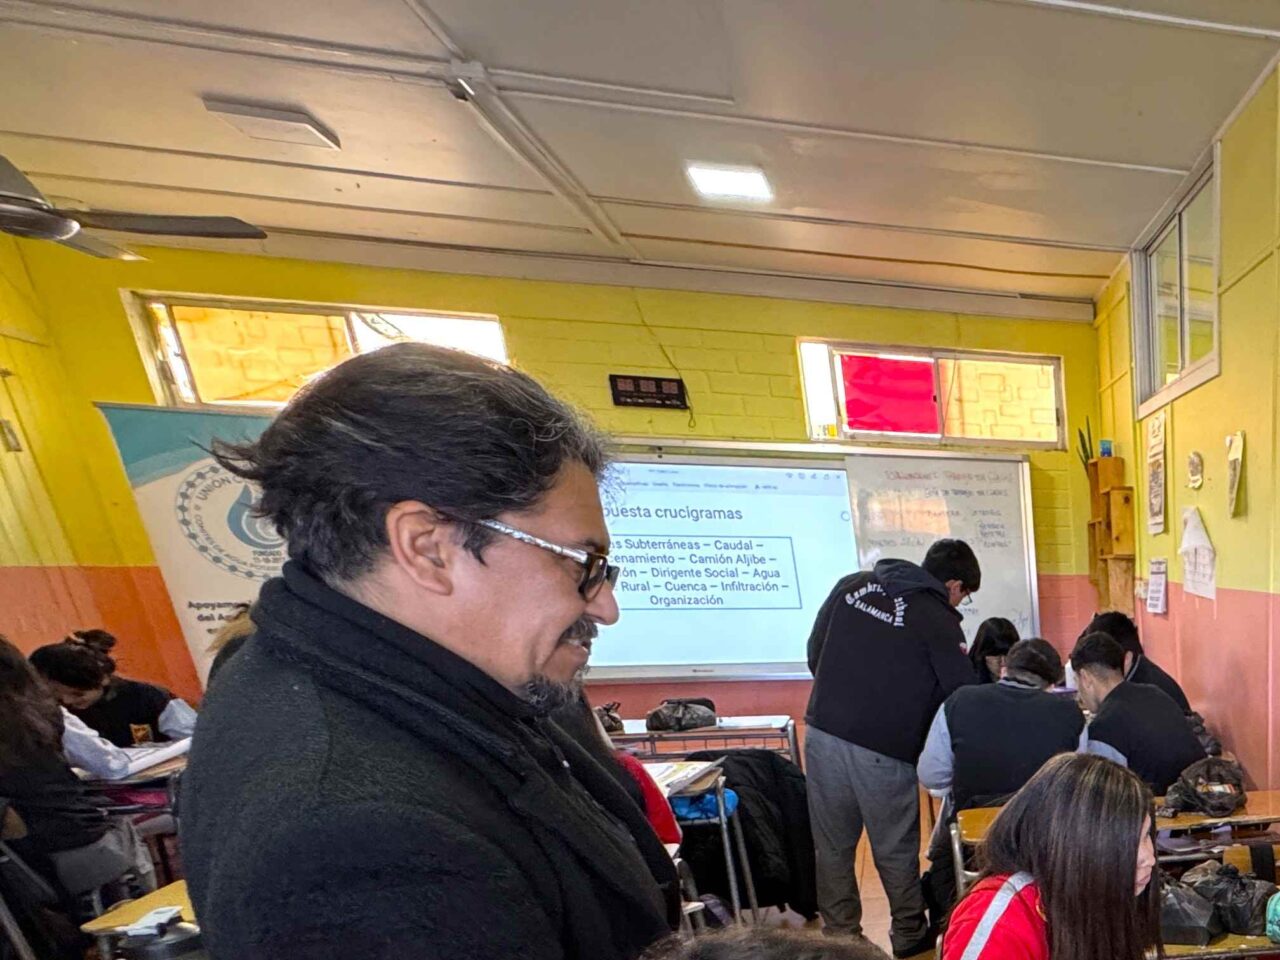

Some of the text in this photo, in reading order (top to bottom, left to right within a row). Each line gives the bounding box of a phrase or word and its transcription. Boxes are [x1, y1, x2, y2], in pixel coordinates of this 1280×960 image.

[604, 505, 743, 521] puesta crucigramas
[624, 539, 701, 550] Subterráneas
[714, 540, 753, 550] Caudal
[610, 553, 766, 567] enamiento Camión Aljibe
[651, 567, 702, 580] Dirigente
[704, 567, 738, 578] Social
[753, 568, 780, 580] Agua
[620, 581, 779, 591] Rural Cuenca Infiltración
[650, 594, 724, 607] Organización
[854, 600, 893, 624] SALAMANCA
